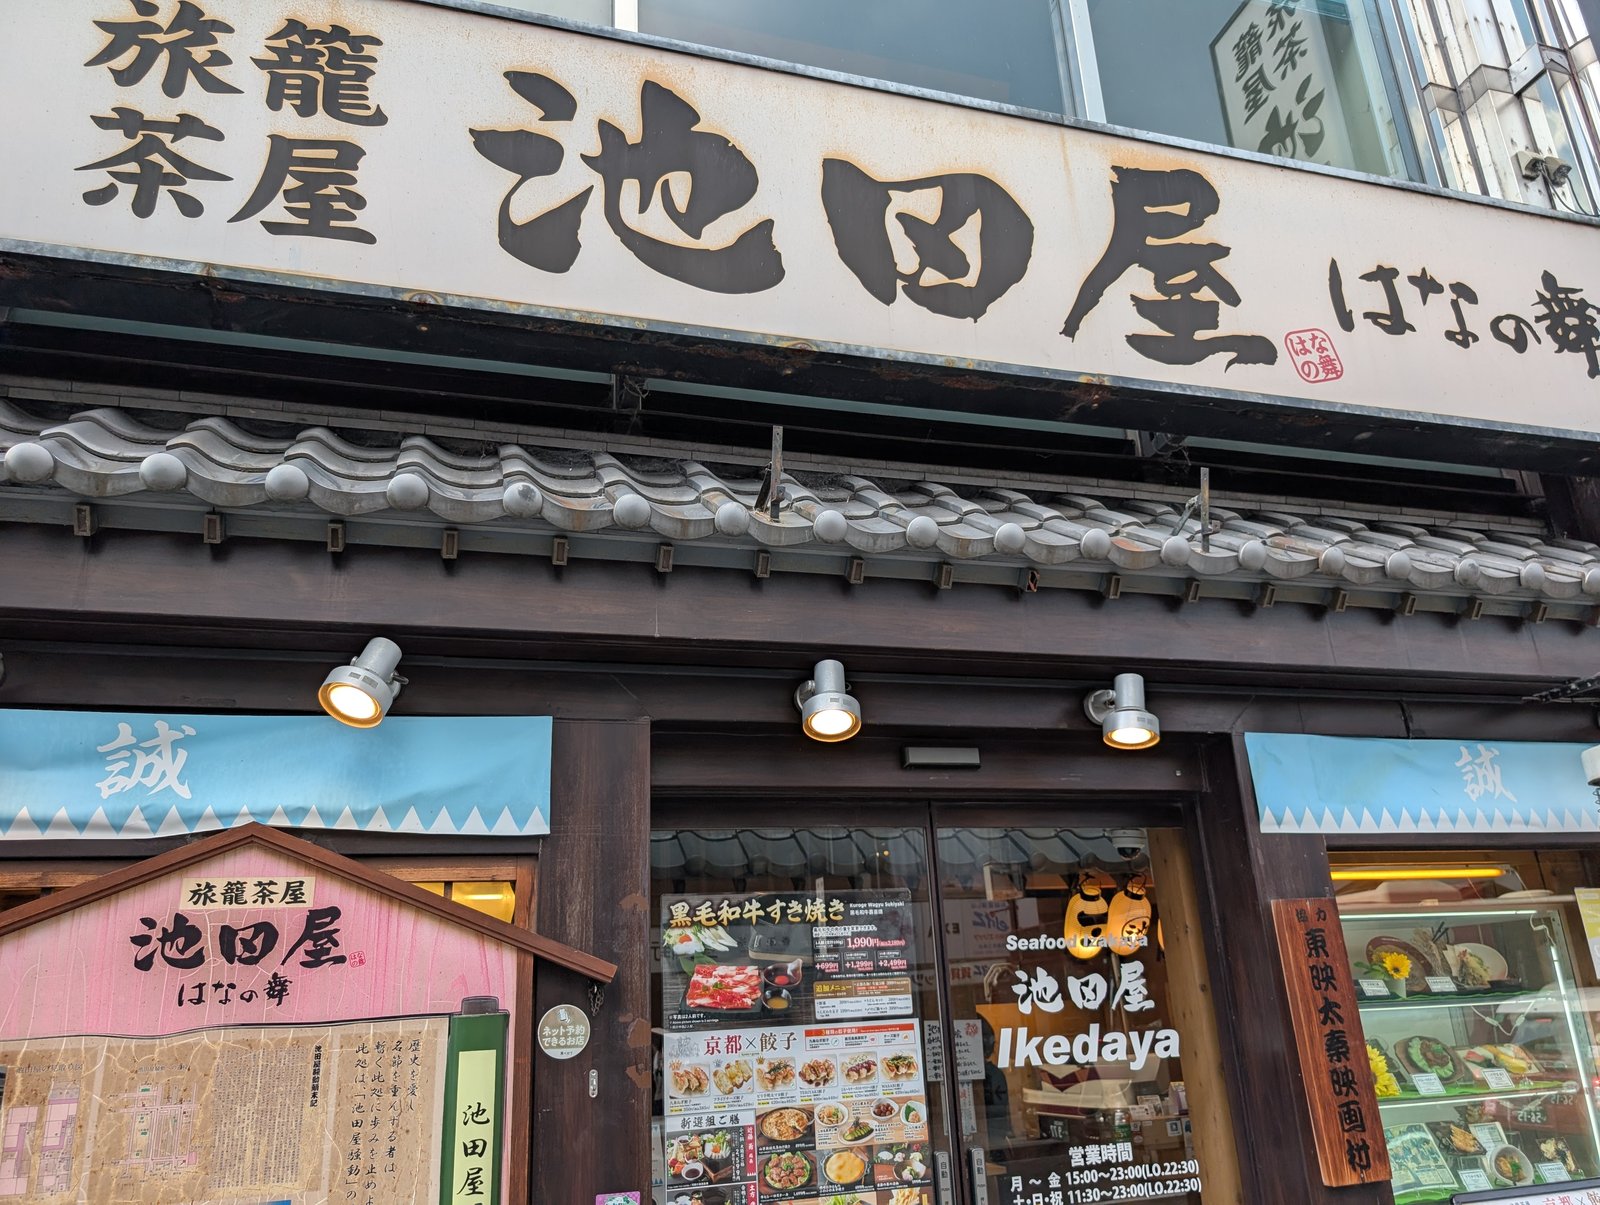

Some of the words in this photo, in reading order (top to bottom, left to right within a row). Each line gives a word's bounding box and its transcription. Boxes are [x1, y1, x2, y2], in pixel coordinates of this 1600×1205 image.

[84, 1, 388, 125] 旅籠
[74, 107, 378, 244] 茶屋
[469, 71, 1278, 373] 池田屋
[95, 719, 197, 800] 誠
[1454, 743, 1518, 803] 誠
[188, 879, 308, 905] 旅籠茶屋
[669, 898, 846, 929] 黒毛和牛すき焼き
[129, 905, 348, 972] 池田屋
[1006, 934, 1077, 951] Seafood
[178, 971, 293, 1007] はなの舞
[1011, 960, 1155, 1015] 池田屋
[542, 1025, 586, 1036] ネット予約
[542, 1036, 585, 1047] できるお店
[997, 1023, 1180, 1071] Ikedaya
[1304, 927, 1372, 1172] 東映太秦映画村
[345, 1042, 370, 1205] 此処は、「池田屋騒動」の
[456, 1101, 491, 1205] 池田屋
[1069, 1142, 1133, 1167] 営業時間
[1010, 1176, 1023, 1192] 月
[1048, 1171, 1061, 1188] 金
